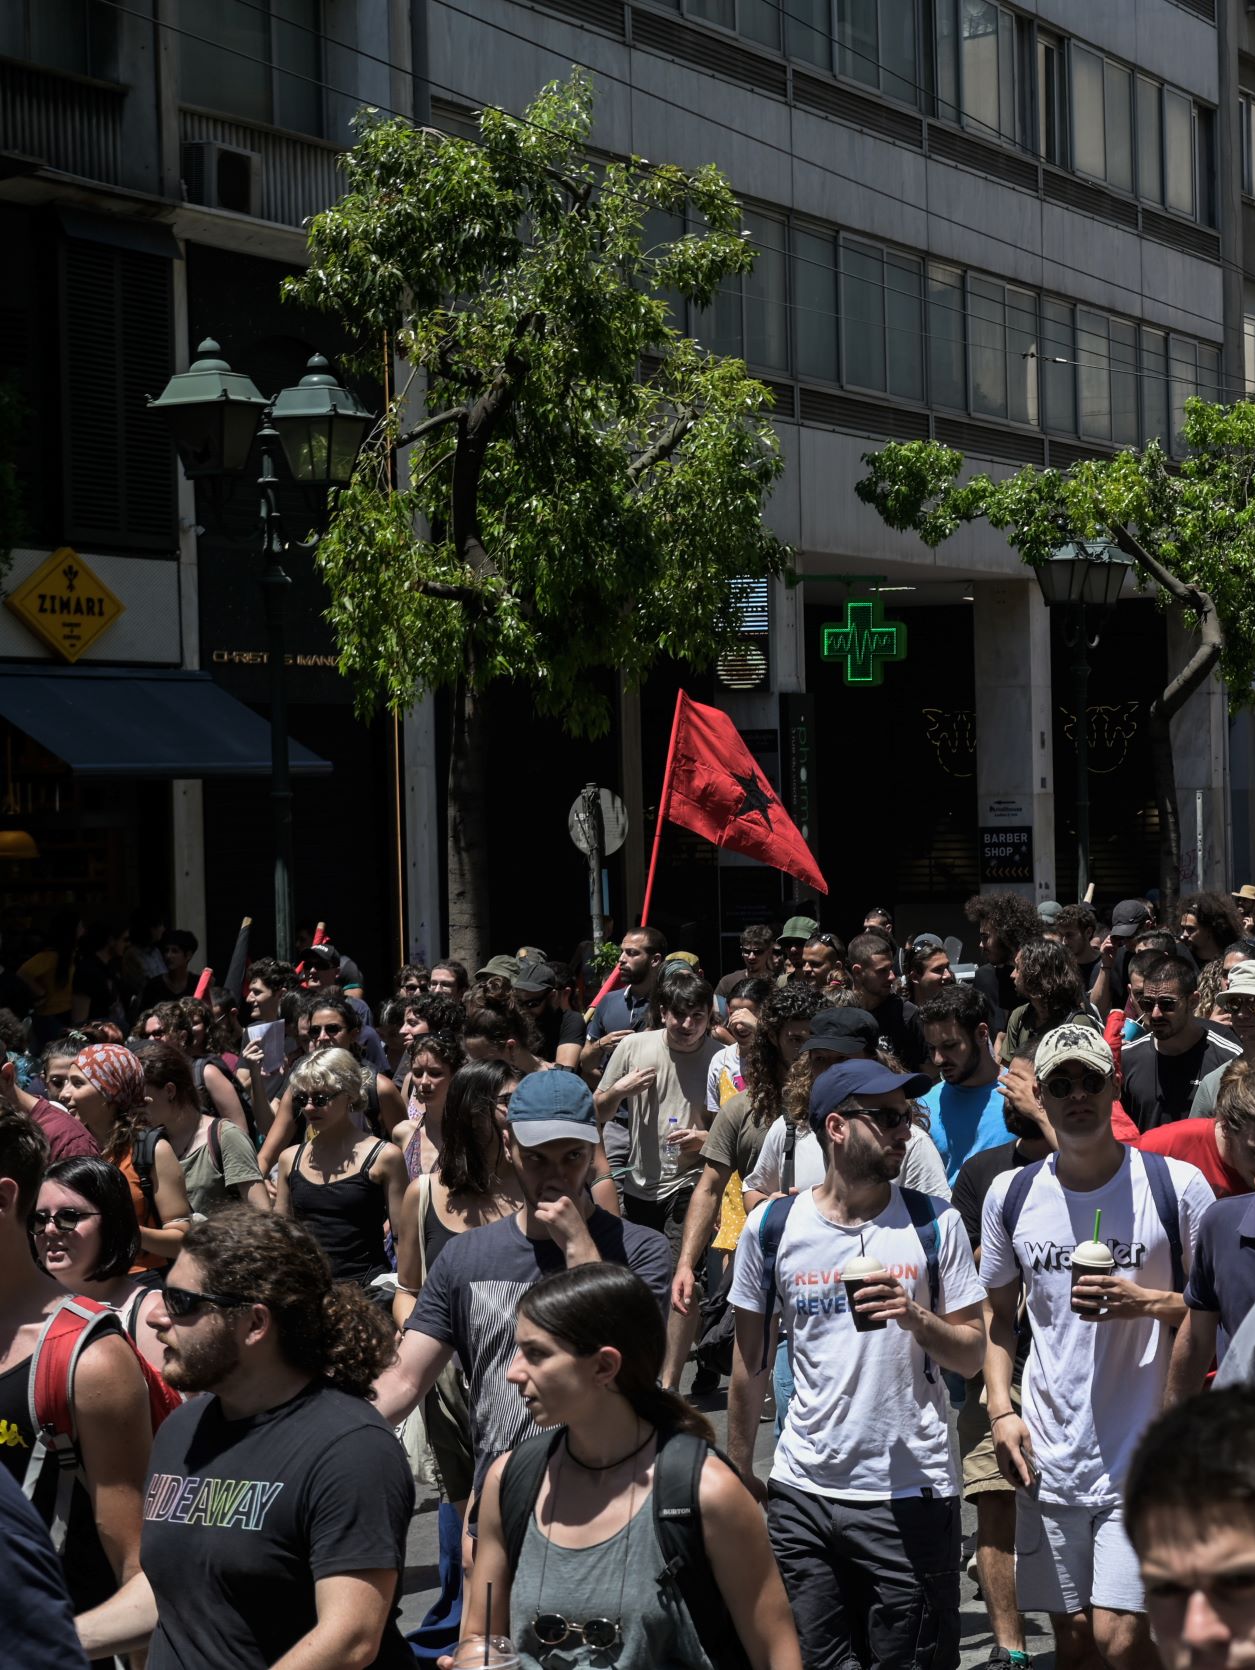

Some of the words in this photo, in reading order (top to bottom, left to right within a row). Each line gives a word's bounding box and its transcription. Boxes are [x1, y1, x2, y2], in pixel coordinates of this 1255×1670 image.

[38, 594, 104, 617] ZIMARI
[984, 832, 1029, 844] BARBER
[984, 847, 1014, 857] SHOP
[1024, 1238, 1146, 1273] Wraler
